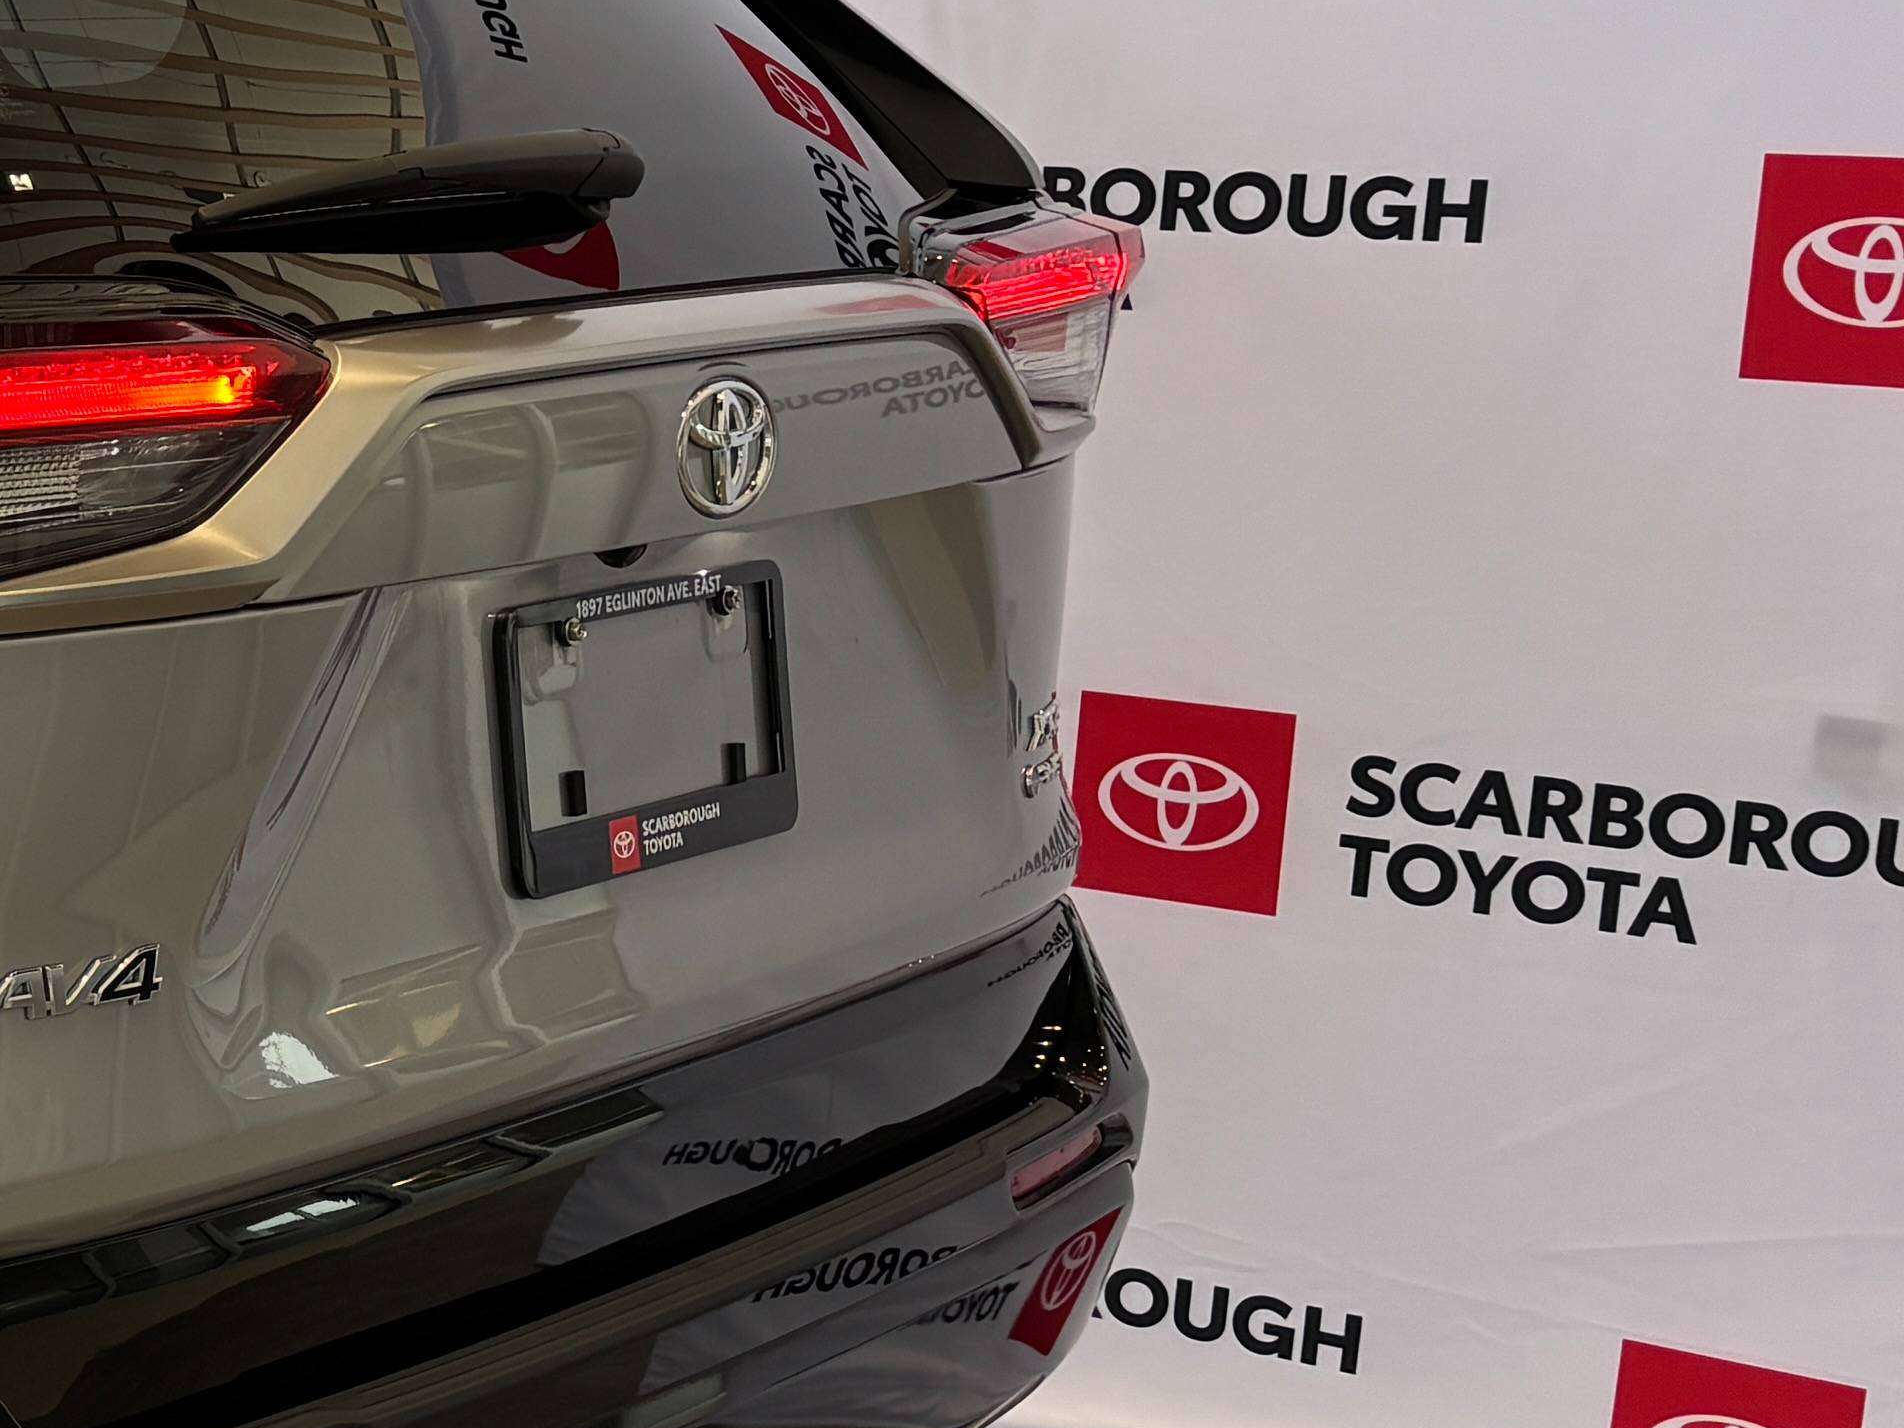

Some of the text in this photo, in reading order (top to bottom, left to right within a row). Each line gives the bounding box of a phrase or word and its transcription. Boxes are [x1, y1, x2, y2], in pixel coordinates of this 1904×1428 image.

[575, 574, 722, 620] 1897 EGLINTON AVE. EAST
[641, 801, 721, 837] SCARBOROUGH
[642, 831, 684, 856] TOYOTA
[1339, 833, 1697, 946] TOYOTA
